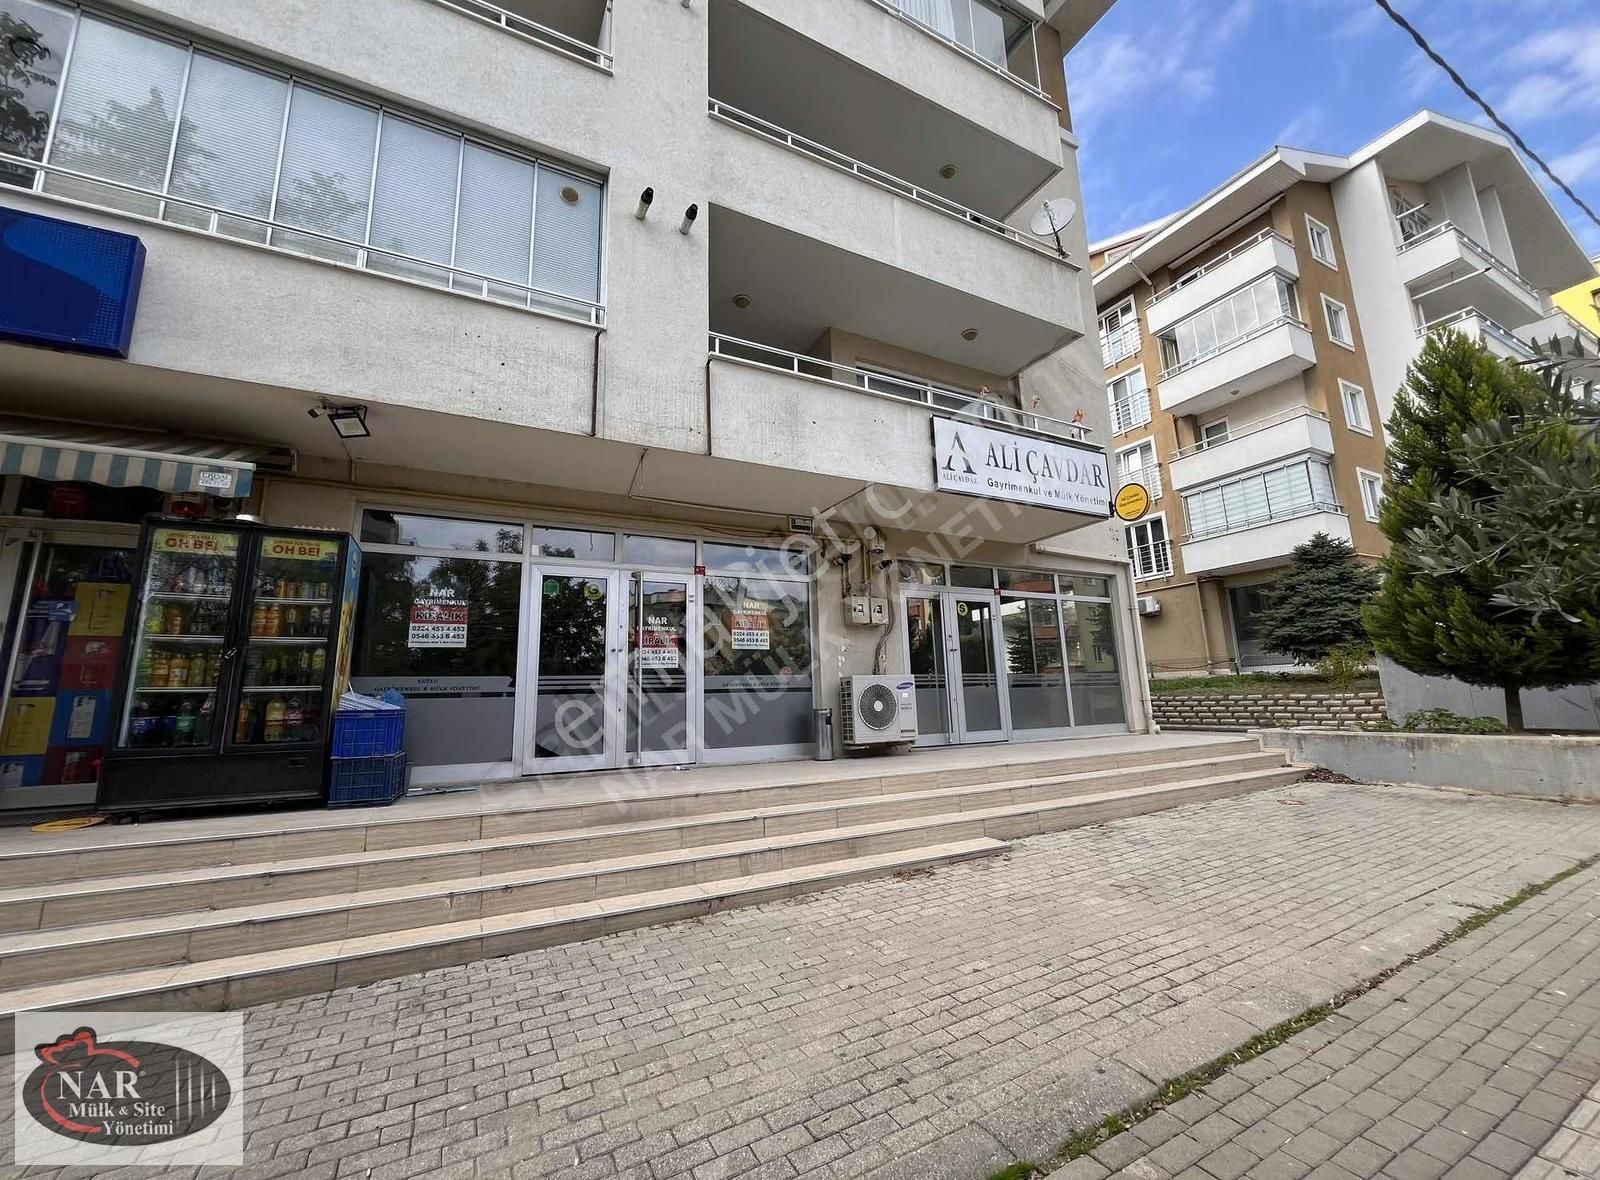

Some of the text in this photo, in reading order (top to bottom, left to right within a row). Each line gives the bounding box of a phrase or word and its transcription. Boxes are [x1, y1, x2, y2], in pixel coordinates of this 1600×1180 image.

[987, 478, 1041, 495] Gayrimenkul
[1043, 489, 1053, 498] ve
[272, 544, 320, 557] OH BE!
[430, 588, 455, 598] NAR
[743, 600, 760, 609] NAR
[648, 615, 668, 625] NAR
